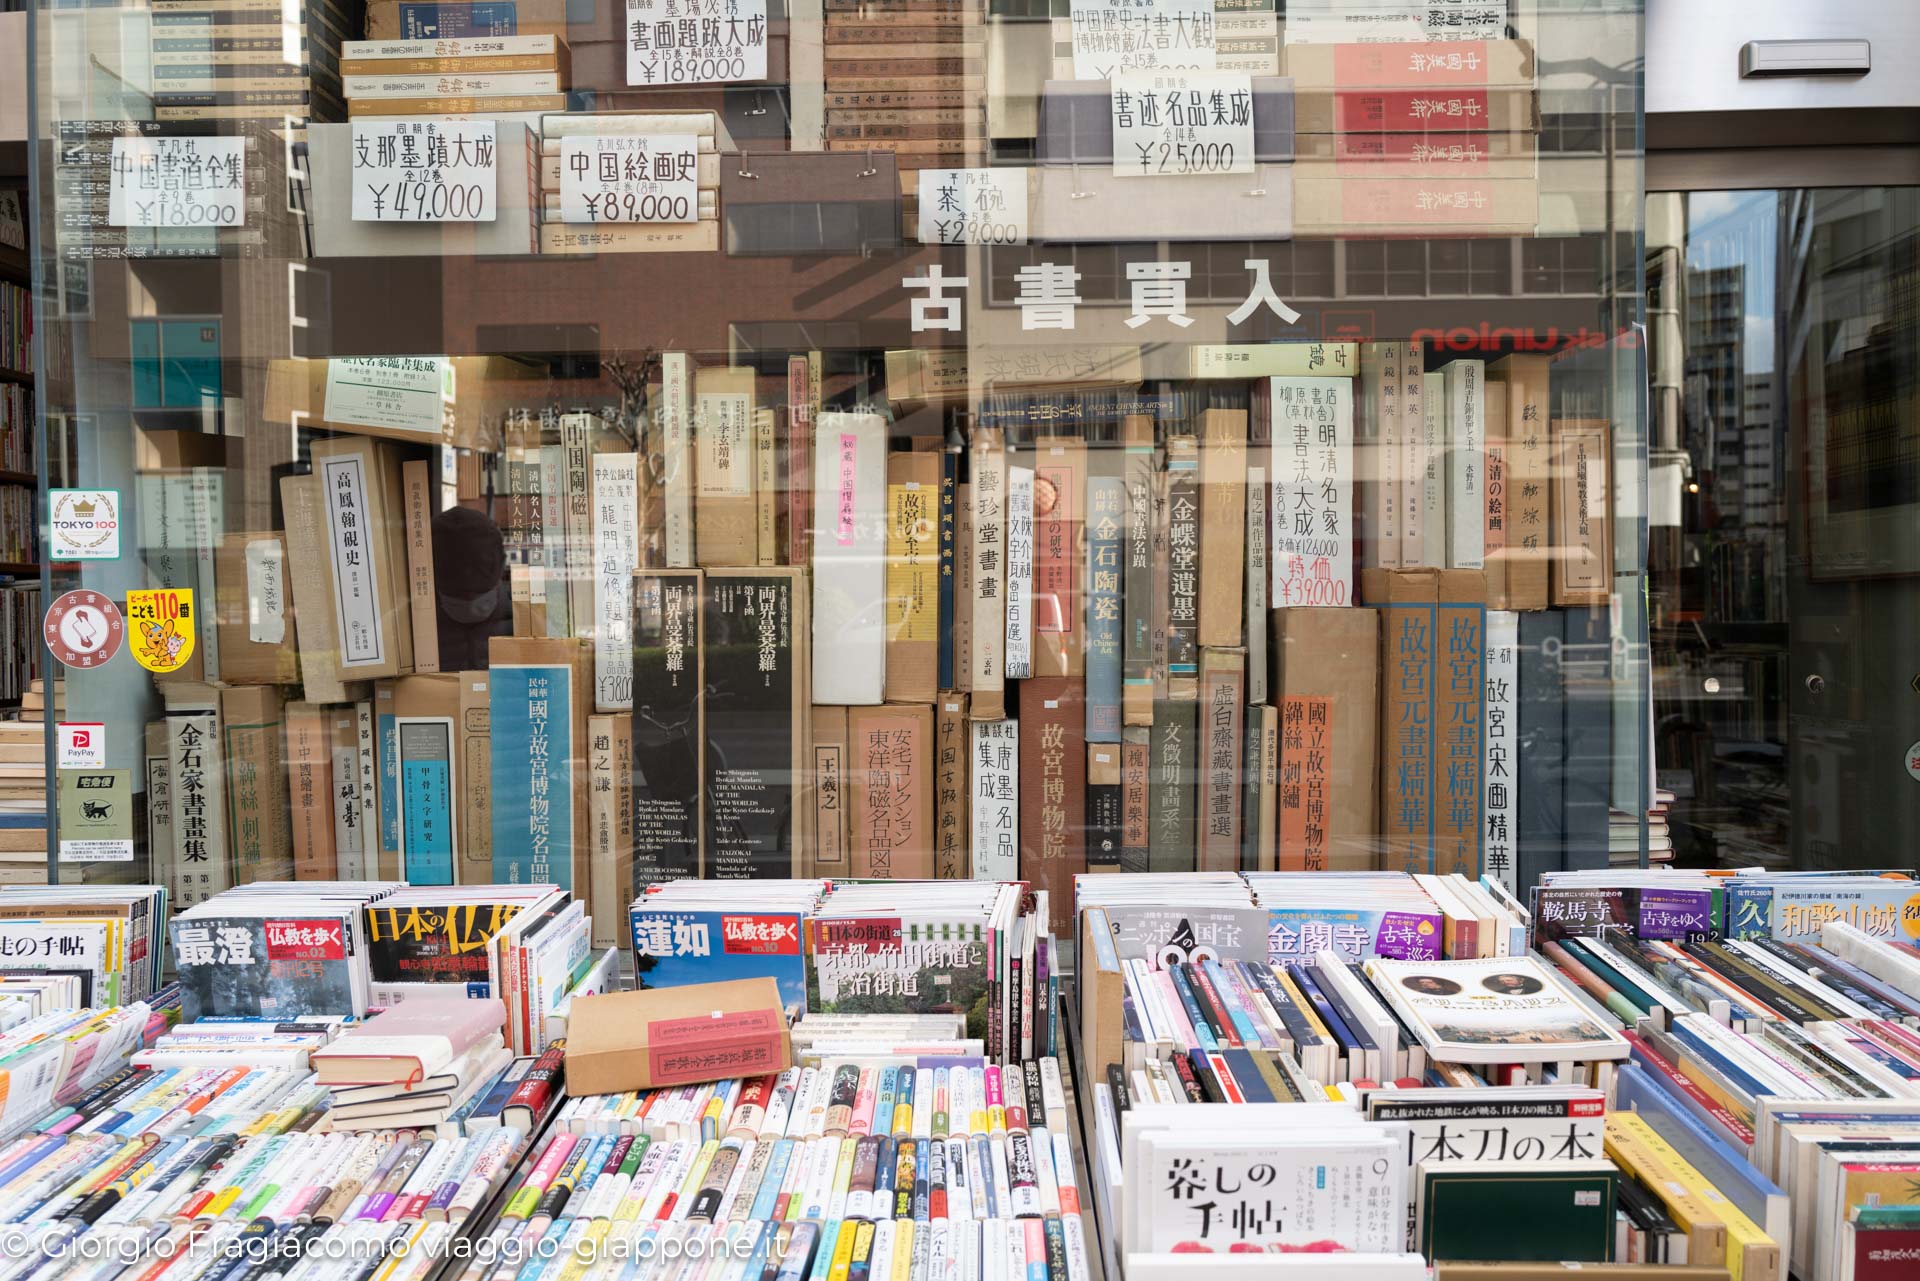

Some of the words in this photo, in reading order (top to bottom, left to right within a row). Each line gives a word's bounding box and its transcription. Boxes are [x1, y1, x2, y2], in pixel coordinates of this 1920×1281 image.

[630, 15, 765, 50] 書画題跋大成
[1114, 89, 1250, 128] 書迹名品集成
[157, 139, 196, 154] 平凡社
[354, 134, 492, 169] 支那墨蹟大成
[1135, 141, 1234, 174] ¥25,000
[112, 151, 243, 190] 中国書道全集
[405, 169, 444, 183] 全12巻
[570, 150, 696, 183] 中国絵画史
[136, 201, 236, 226] ¥18,000
[368, 181, 483, 219] ¥49,000
[582, 192, 689, 222] ¥89,000
[934, 219, 1018, 244] ¥29,000
[902, 259, 1300, 331] 古書買入
[1279, 386, 1337, 405] 柳原書店
[1293, 424, 1314, 537] 書法大成
[1318, 424, 1340, 537] 明清名家
[1488, 447, 1502, 531] 明清の絵画
[52, 520, 94, 530] TOKYO
[95, 520, 117, 530] 100
[1288, 555, 1332, 580] 特価
[1280, 579, 1346, 606] ¥39,000
[1397, 617, 1427, 834] 故宮元畫精華
[1446, 617, 1477, 834] 故宮元畫精華
[68, 749, 95, 757] PayPay
[80, 777, 112, 788] 宅急便
[892, 730, 912, 847] 安宅コレクション
[1042, 723, 1065, 859] 故宮博物院
[1304, 702, 1326, 871] 國立故宮博物院
[996, 745, 1014, 858] 唐墨名品
[1542, 901, 1612, 921] 鞍馬寺
[1642, 911, 1704, 929] 古寺をゆく
[1781, 903, 1897, 939] 和歌山城
[176, 927, 255, 966] 最澄
[269, 927, 342, 946] 仏教を歩く
[635, 919, 711, 957] 蓮如
[725, 923, 798, 941] 仏教を歩く
[829, 927, 891, 941] 日本の街道
[1268, 923, 1371, 956] 金閣寺
[824, 972, 920, 997] 宇治街道
[1186, 1200, 1288, 1239] 手帖
